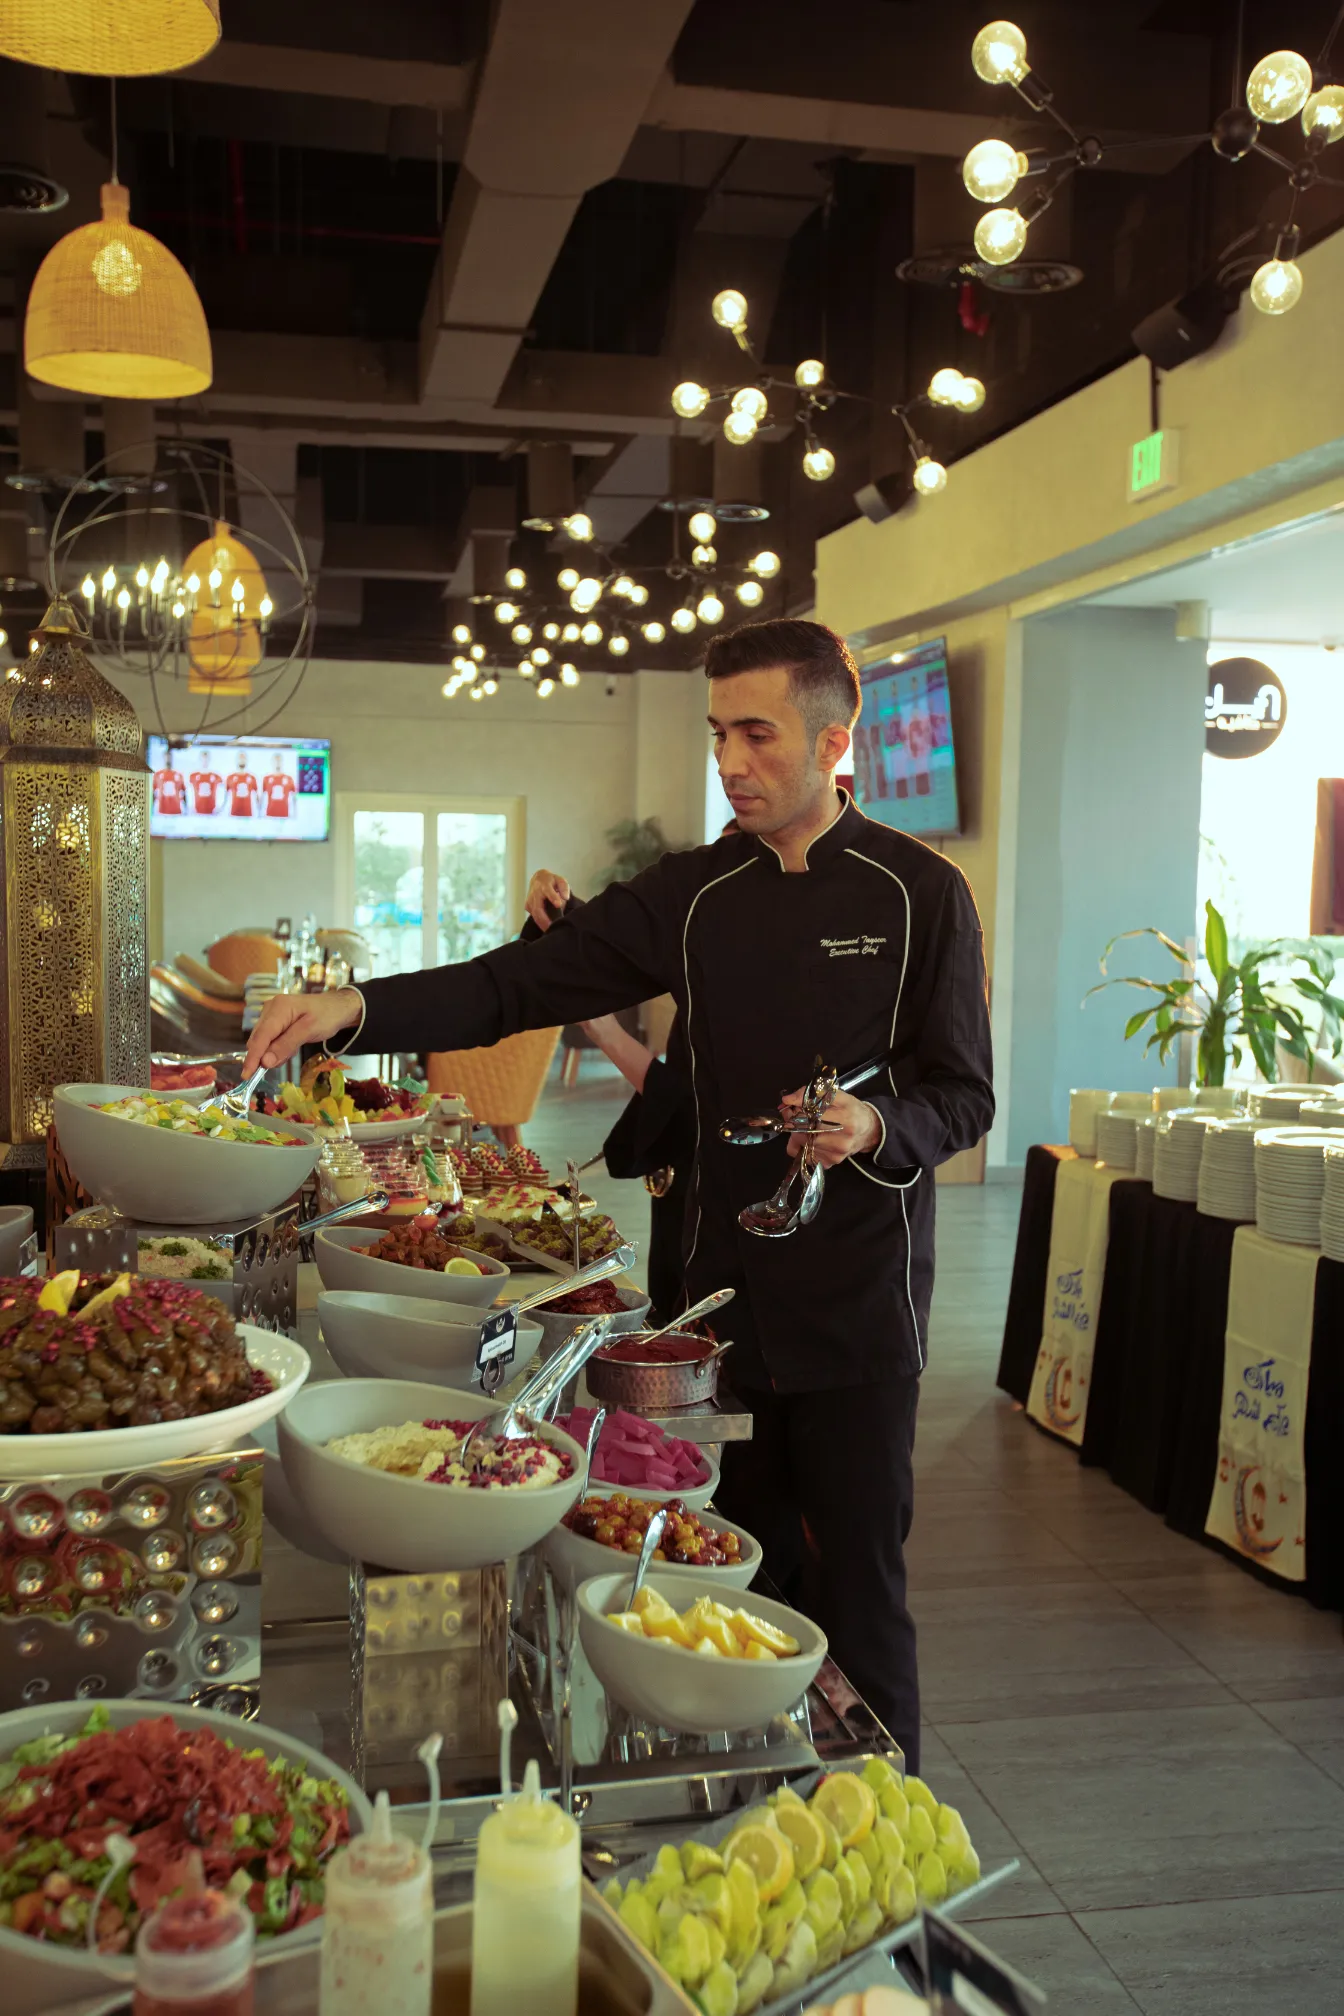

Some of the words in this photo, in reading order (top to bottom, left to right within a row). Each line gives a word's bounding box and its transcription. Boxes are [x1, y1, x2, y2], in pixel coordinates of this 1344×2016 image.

[1132, 431, 1163, 492] EXIT
[829, 948, 860, 957] Executive
[861, 945, 880, 955] Chef
